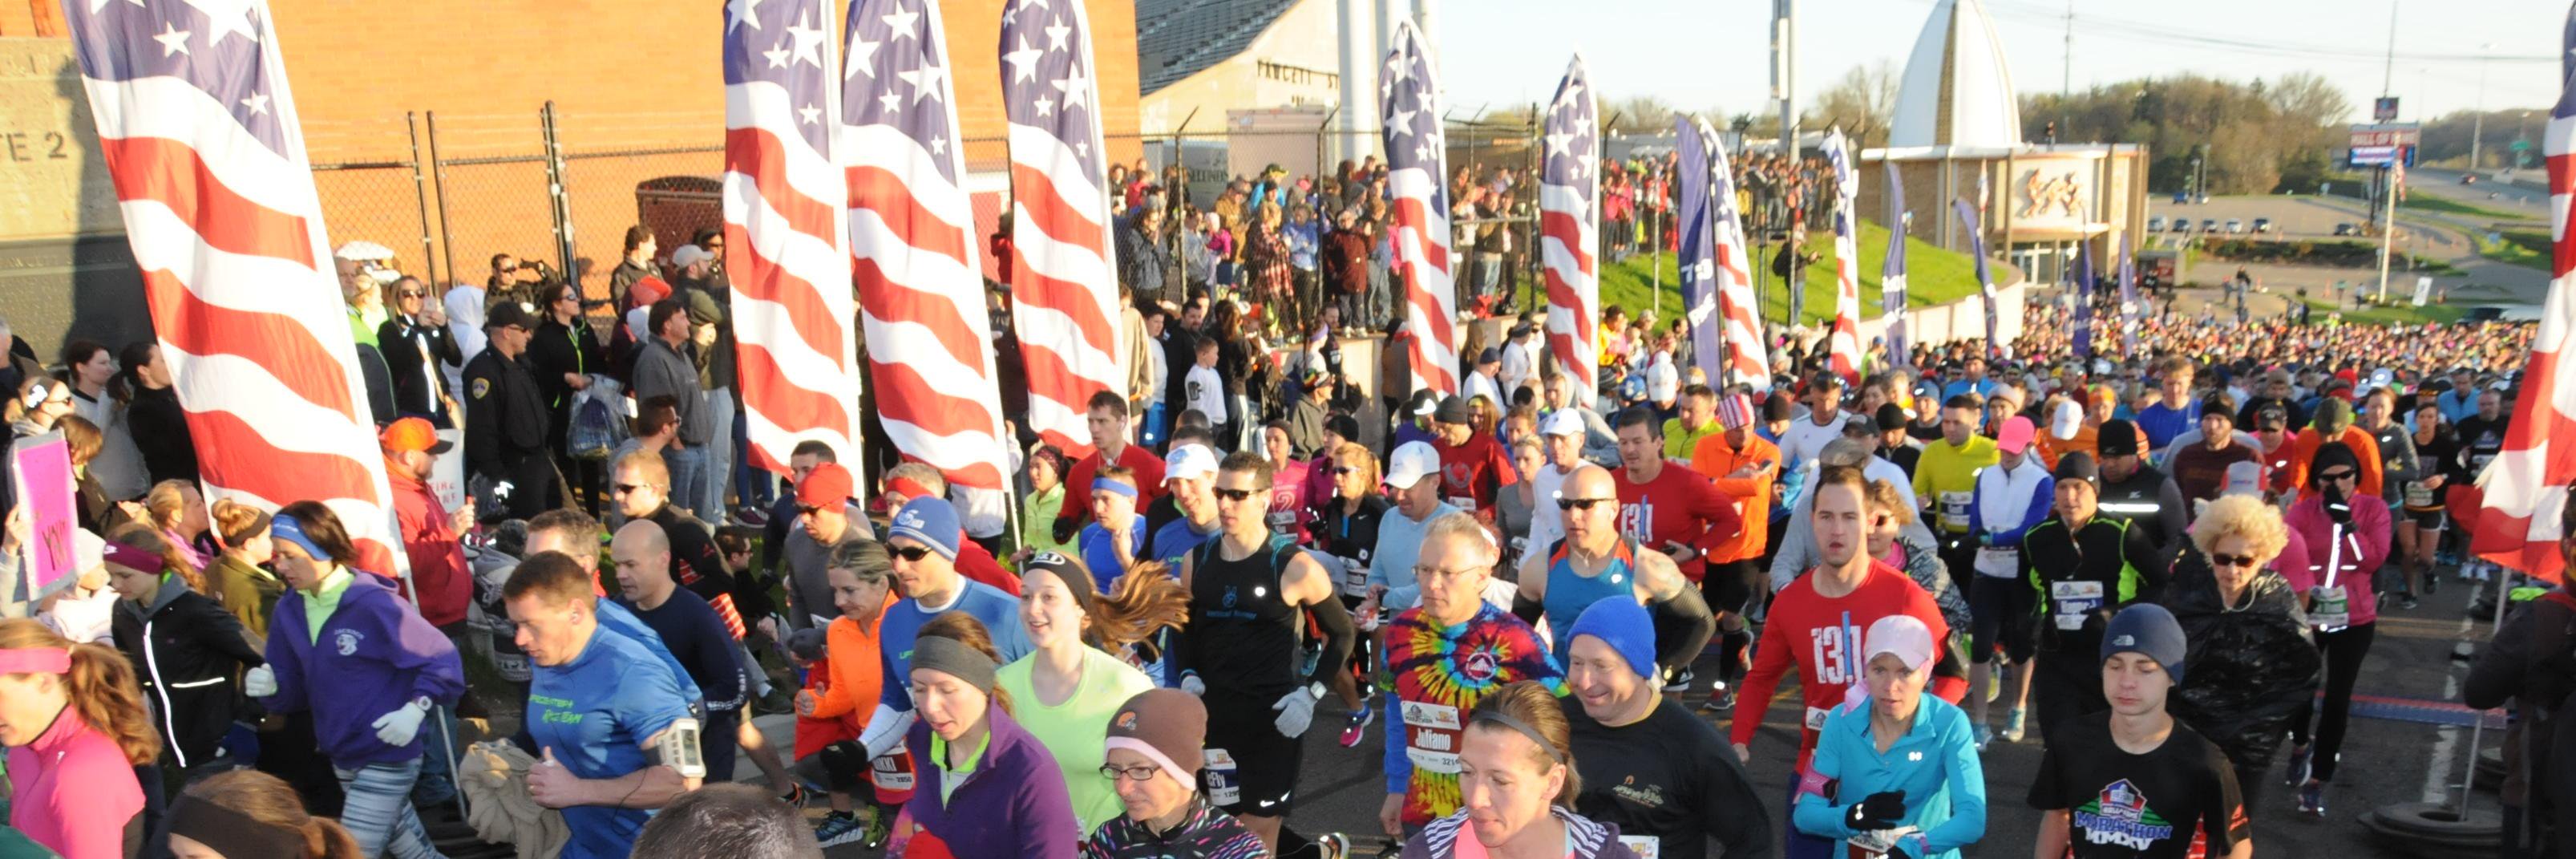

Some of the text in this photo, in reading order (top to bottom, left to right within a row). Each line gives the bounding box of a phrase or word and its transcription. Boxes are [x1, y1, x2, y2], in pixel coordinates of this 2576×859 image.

[0, 131, 67, 162] E 2
[1810, 624, 1863, 685] 13.1
[1415, 727, 1451, 752] Juliano
[2074, 810, 2174, 841] MARATHON
